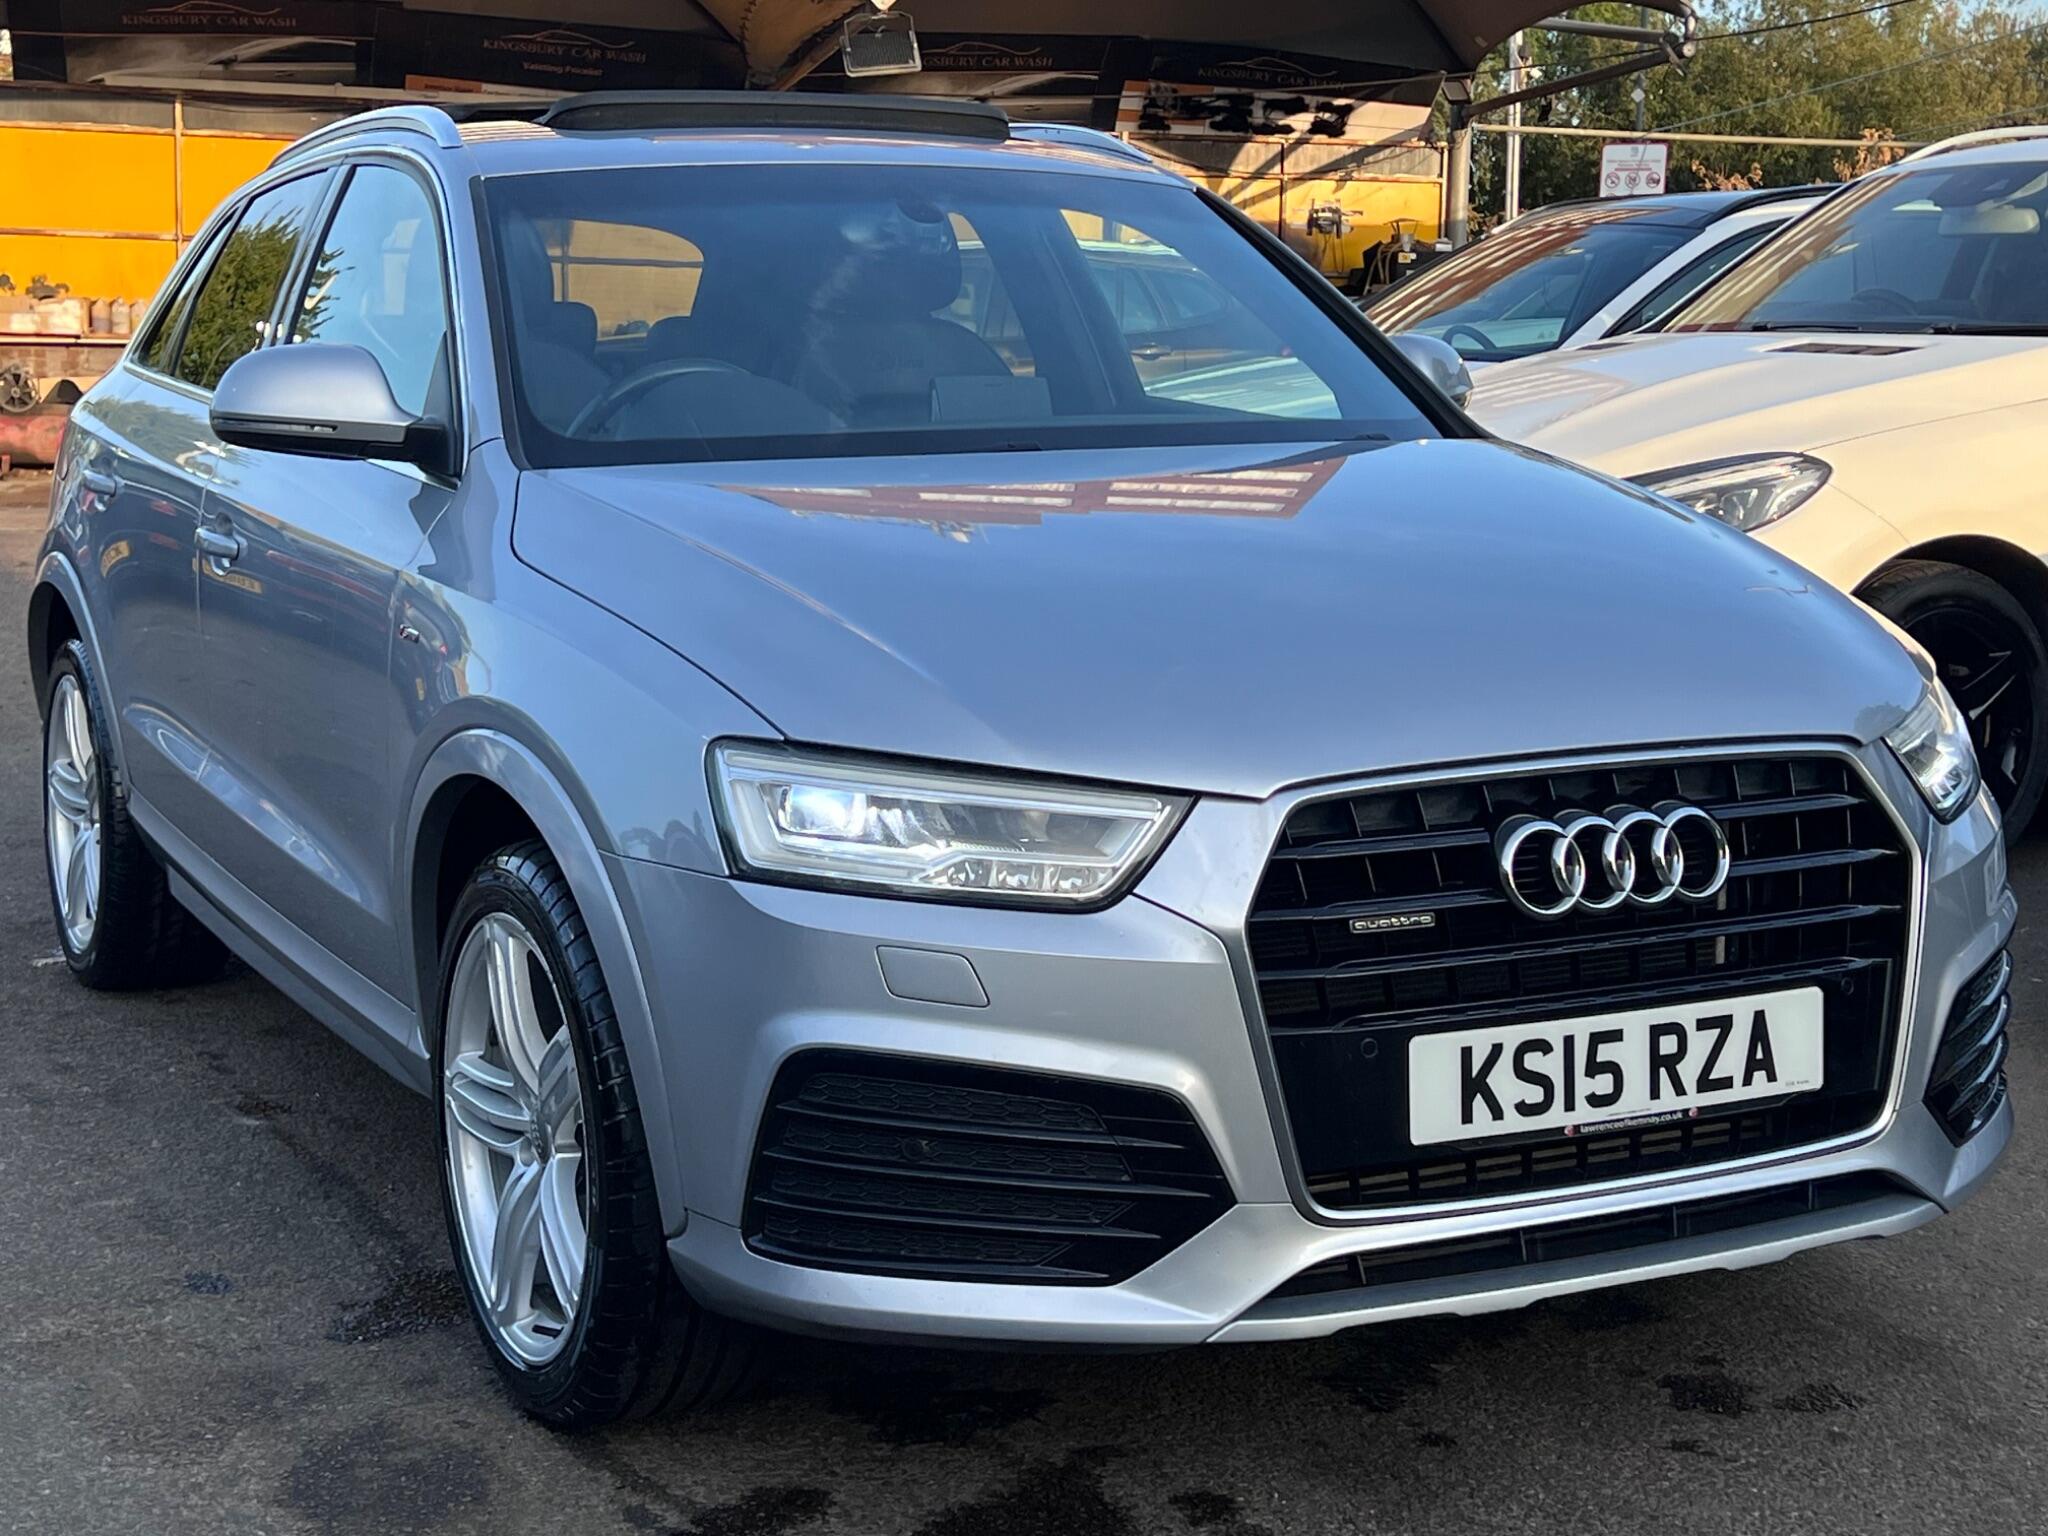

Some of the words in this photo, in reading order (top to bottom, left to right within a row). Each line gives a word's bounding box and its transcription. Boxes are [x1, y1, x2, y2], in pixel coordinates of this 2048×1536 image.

[121, 14, 210, 25] KINGSBURY
[216, 15, 249, 26] CAR
[253, 16, 297, 27] WASH
[483, 38, 565, 56] KINGSBURY
[571, 46, 602, 60] CAR
[606, 49, 647, 64] WASH
[923, 55, 978, 66] GSBURY
[981, 55, 1010, 67] CAR
[1013, 56, 1053, 67] WASH
[1198, 67, 1272, 82] KINGSBURY
[1277, 72, 1306, 86] CAR
[1354, 915, 1432, 930] quattro
[1460, 1028, 1625, 1125] KS15
[1649, 1009, 1778, 1101] RZA
